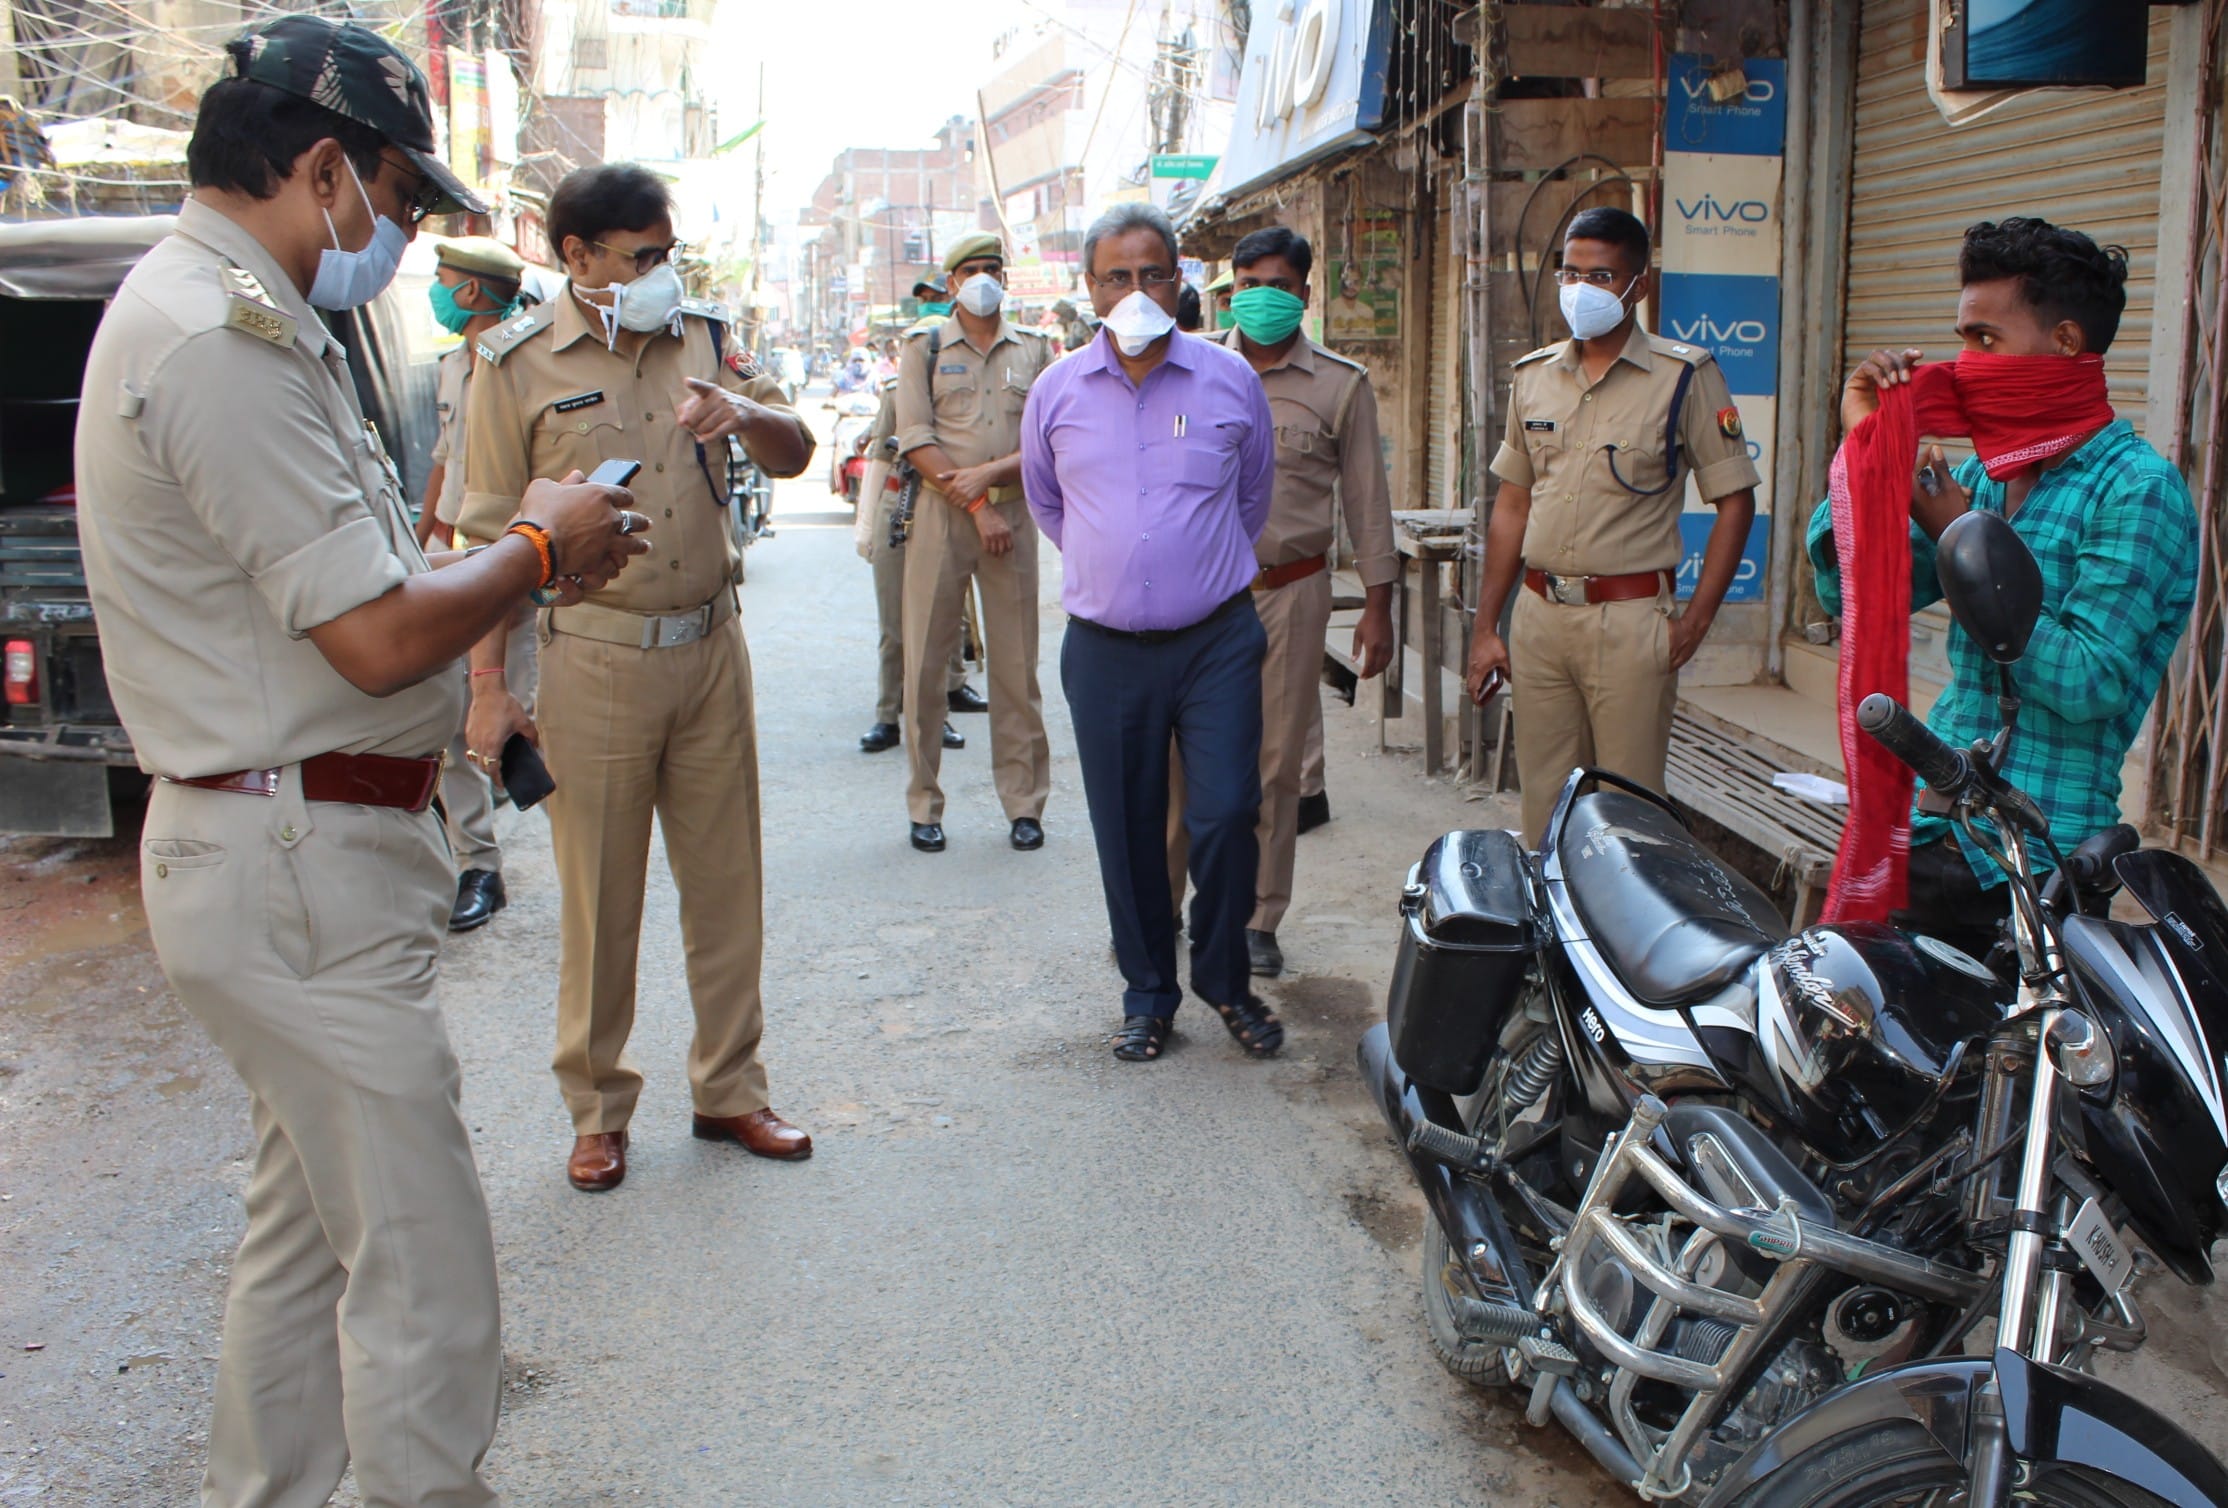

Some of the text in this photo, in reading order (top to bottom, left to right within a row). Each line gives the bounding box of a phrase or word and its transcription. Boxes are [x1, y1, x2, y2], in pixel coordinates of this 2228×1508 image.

[1681, 77, 1774, 101] vo
[1688, 102, 1762, 117] Smart Phone
[1676, 193, 1768, 222] vivo
[1685, 224, 1757, 237] Smart Phone
[1672, 313, 1766, 342] vivo
[1719, 345, 1754, 357] Phone
[1582, 1006, 1605, 1042] Hero
